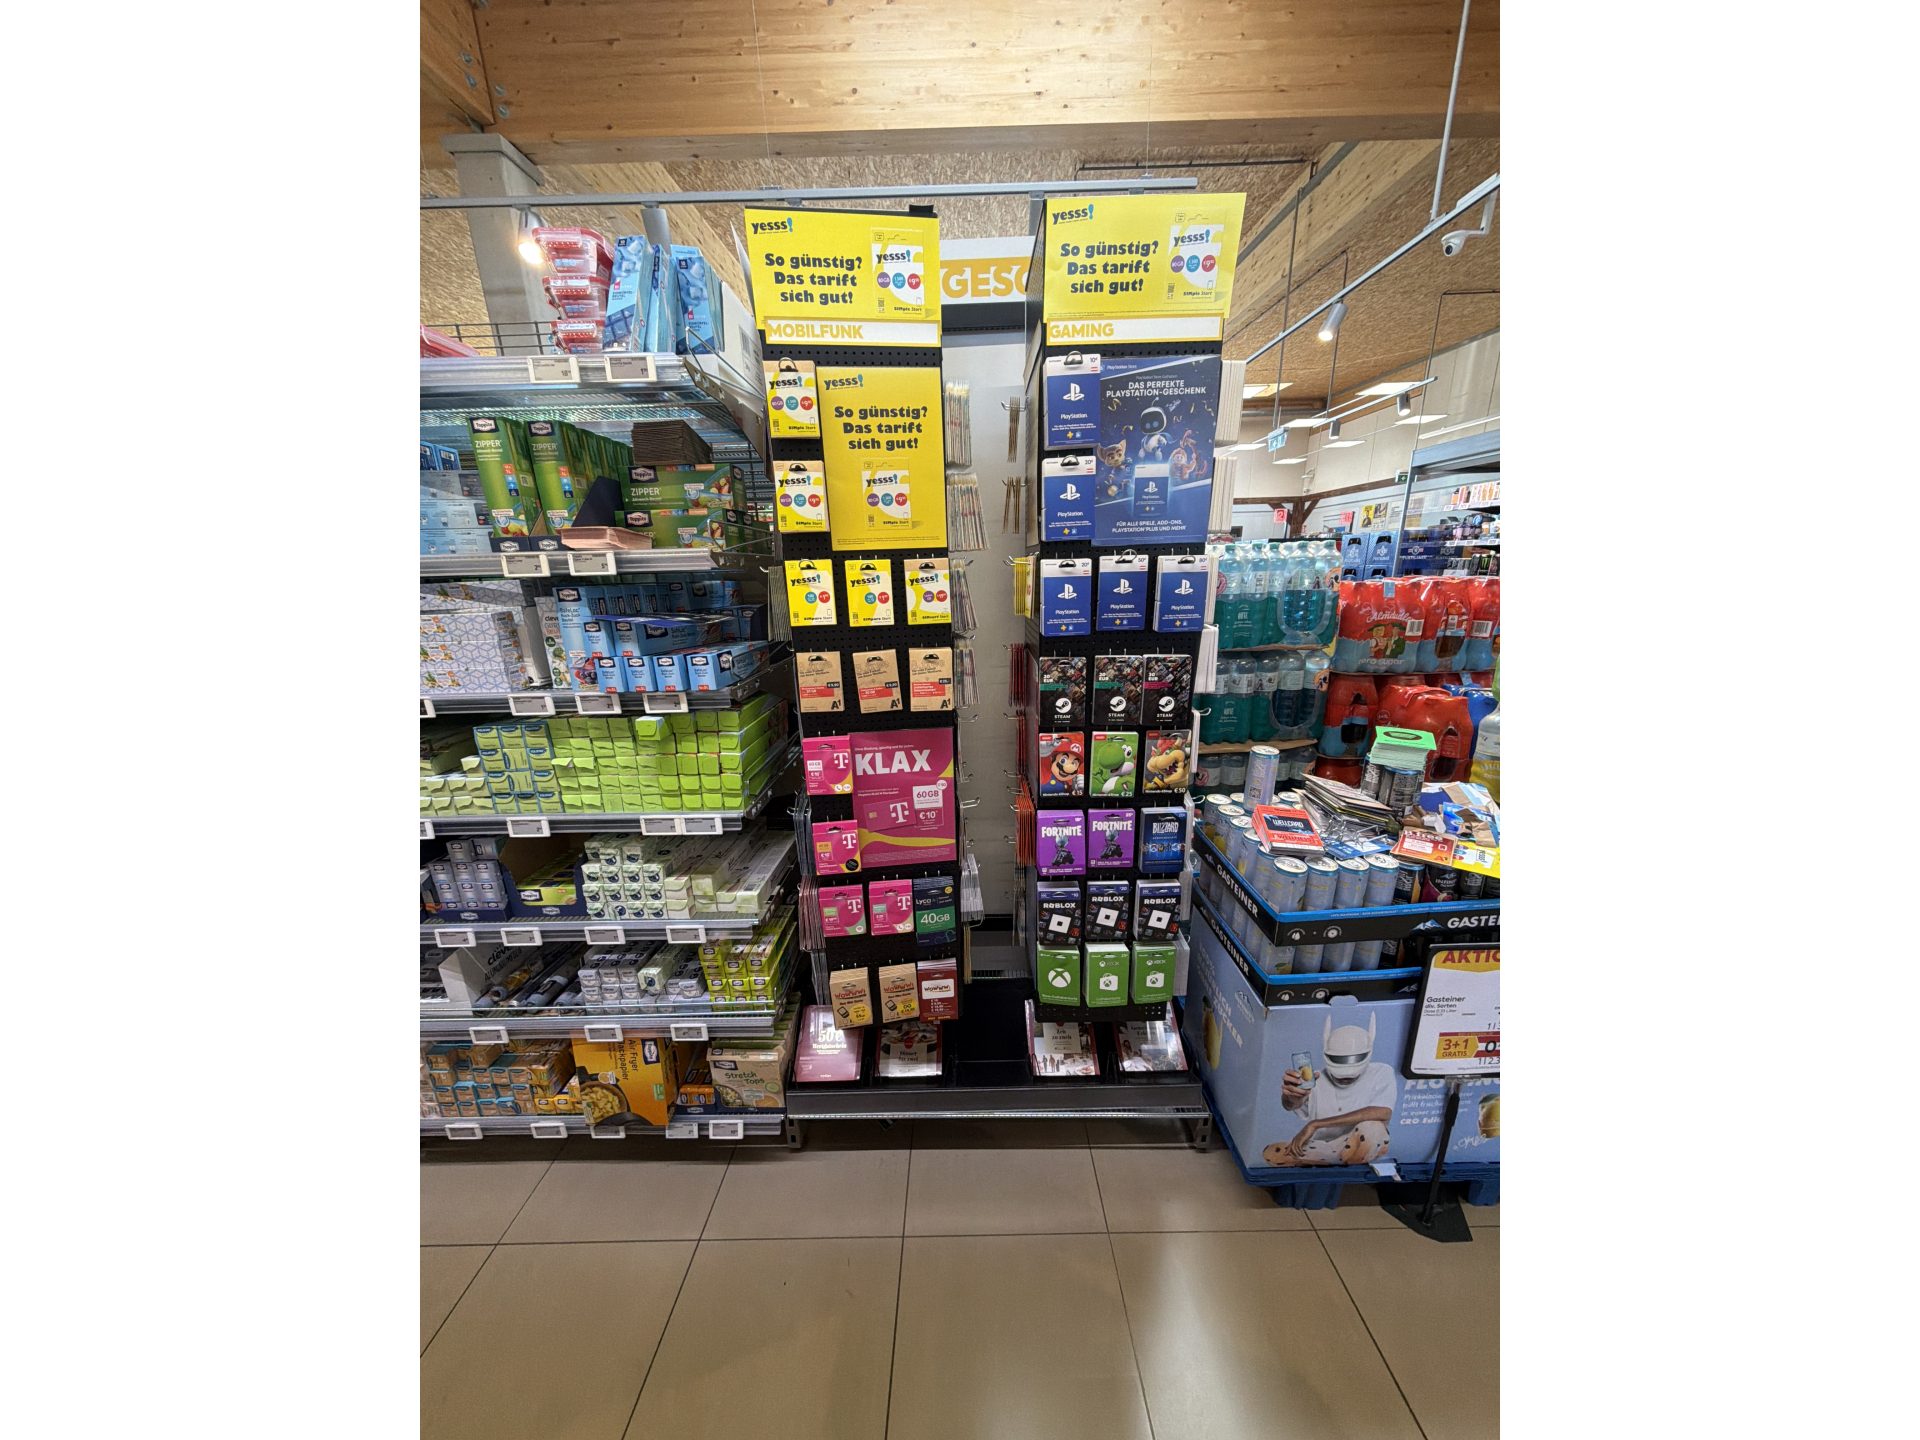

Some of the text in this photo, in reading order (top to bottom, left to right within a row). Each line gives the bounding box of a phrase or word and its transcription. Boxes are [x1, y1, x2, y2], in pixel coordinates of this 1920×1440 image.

[1052, 204, 1094, 225] yesss!
[751, 217, 793, 234] yesss!
[1174, 229, 1211, 247] yesss!
[1060, 240, 1159, 258] So günstig?
[764, 253, 862, 272] So günstig?
[876, 250, 911, 264] yesss!
[1067, 260, 1150, 276] Das tarift
[774, 272, 858, 287] Das tarift
[1070, 278, 1144, 294] sich gut!
[780, 290, 853, 306] sich gut!
[769, 324, 864, 340] MOBILFUNK
[1050, 322, 1114, 339] GAMING
[769, 376, 802, 390] yesss!
[824, 374, 864, 390] yesss!
[1147, 380, 1184, 388] PERFEKTE
[1106, 387, 1206, 397] PLAYSTATION-GESCHENK
[834, 406, 928, 420] So günstig?
[843, 422, 922, 434] Das tarift
[848, 438, 918, 451] sich gut!
[778, 475, 811, 488] yesss!
[866, 474, 898, 488] yesss!
[791, 574, 821, 586] yesss!
[850, 575, 880, 588] yesss!
[909, 574, 938, 586] yesss!
[855, 750, 932, 776] KLAX
[928, 790, 939, 798] GB
[1042, 826, 1082, 838] FORTNITE
[1092, 821, 1132, 832] FORTNITE
[1152, 822, 1179, 834] BLIZZARD
[1216, 864, 1258, 918] GASTEINER
[921, 913, 950, 924] 40GB
[1211, 919, 1249, 976] GASTEINER
[629, 1052, 638, 1072] Fryer
